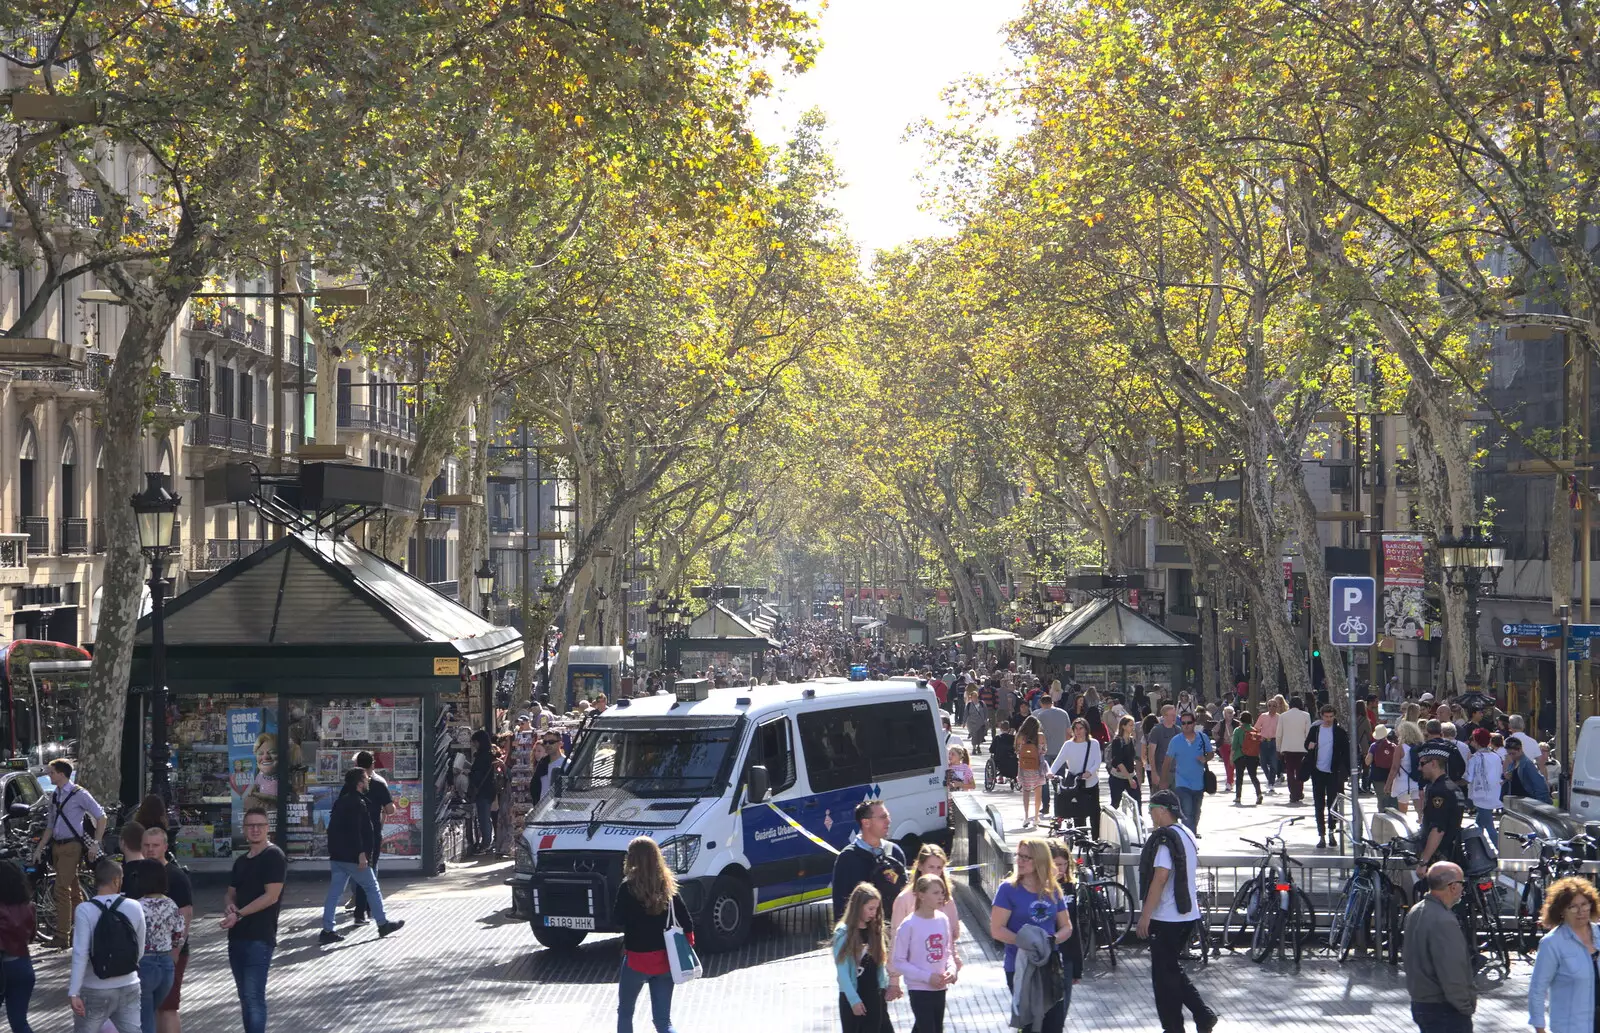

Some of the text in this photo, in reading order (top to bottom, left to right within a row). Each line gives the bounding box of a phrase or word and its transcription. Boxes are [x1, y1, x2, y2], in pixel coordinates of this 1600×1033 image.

[1344, 587, 1362, 611] P
[232, 733, 257, 744] VOLA!
[604, 827, 654, 837] Urbana
[550, 917, 592, 929] 6189 HHK
[925, 933, 943, 964] S
